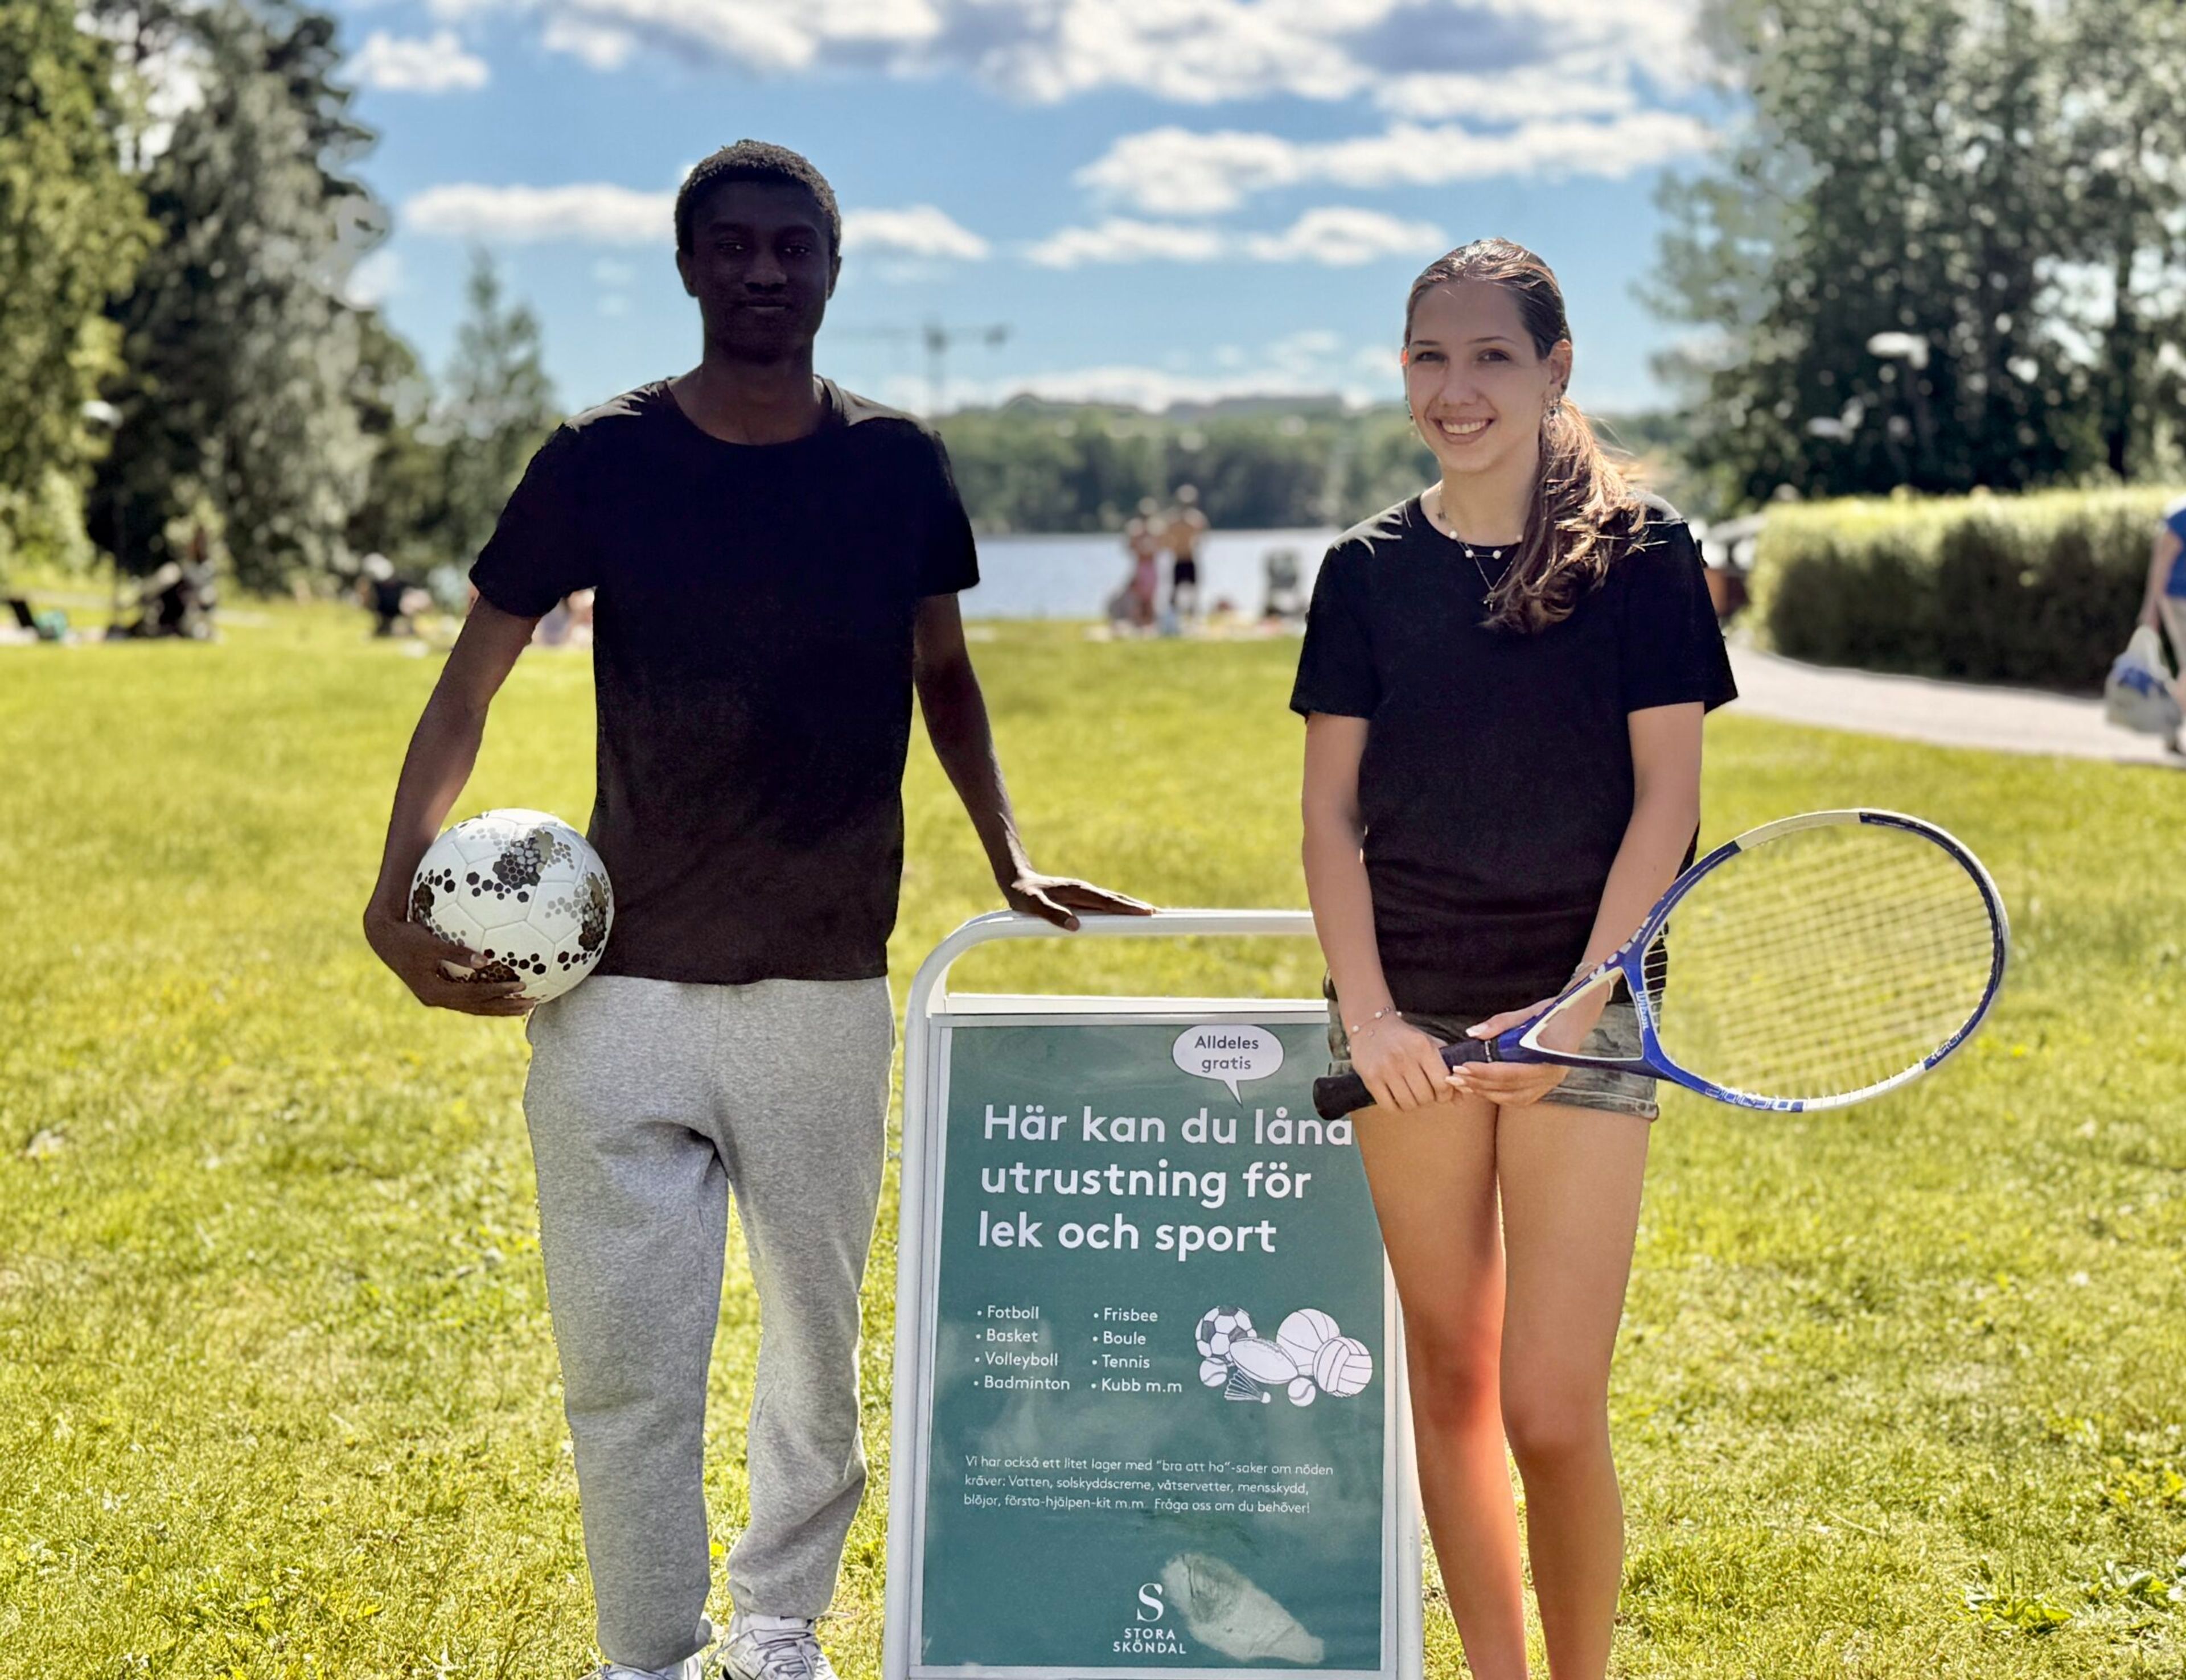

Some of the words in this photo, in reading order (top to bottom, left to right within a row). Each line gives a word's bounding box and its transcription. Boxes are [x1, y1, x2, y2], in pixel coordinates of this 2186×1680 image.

[1194, 1035, 1259, 1050] Alldeles
[1201, 1055, 1251, 1072] gratis
[984, 1104, 1067, 1140] Här
[1082, 1106, 1165, 1143] kan
[1181, 1107, 1236, 1143] du
[1255, 1106, 1352, 1145] låna
[981, 1159, 1227, 1208] utrustning
[1242, 1162, 1312, 1199] för
[978, 1211, 1043, 1247] lek
[1058, 1213, 1139, 1250] och
[1154, 1220, 1277, 1262] sport
[987, 1306, 1039, 1320] Fotboll
[1103, 1307, 1159, 1322] Frisbee
[986, 1328, 1038, 1343] Basket
[1103, 1331, 1147, 1345] Boule
[985, 1351, 1059, 1369] Volleyboll
[1102, 1354, 1150, 1369] Tennis
[984, 1375, 1070, 1390] Badminton
[1102, 1377, 1141, 1391] Kubb
[1146, 1381, 1182, 1393] m.m
[965, 1455, 977, 1467] Vi
[981, 1455, 1001, 1467] har
[1004, 1456, 1039, 1468] också
[1042, 1459, 1061, 1468] ett
[1064, 1457, 1087, 1469] litet
[1092, 1458, 1121, 1473] lager
[1125, 1459, 1152, 1471] med
[1186, 1462, 1205, 1472] att
[1271, 1465, 1291, 1475] om
[1295, 1464, 1333, 1476] nöden
[965, 1474, 1006, 1487] kräver:
[1009, 1475, 1053, 1489] Vatten,
[1057, 1477, 1154, 1492] solskyddscreme,
[1157, 1480, 1234, 1493] våtservetter,
[1238, 1482, 1309, 1496] mensskydd,
[964, 1493, 1001, 1508] blöjor,
[1005, 1494, 1111, 1510] första-hjälpen-kit
[1154, 1498, 1189, 1513] Fråga
[1192, 1501, 1211, 1511] oss
[1214, 1502, 1235, 1512] om
[1238, 1500, 1254, 1512] du
[1258, 1501, 1310, 1514] behöver!
[1137, 1583, 1164, 1622] S
[1124, 1628, 1176, 1640] STORA
[1113, 1639, 1186, 1654] SKÖNDAL
